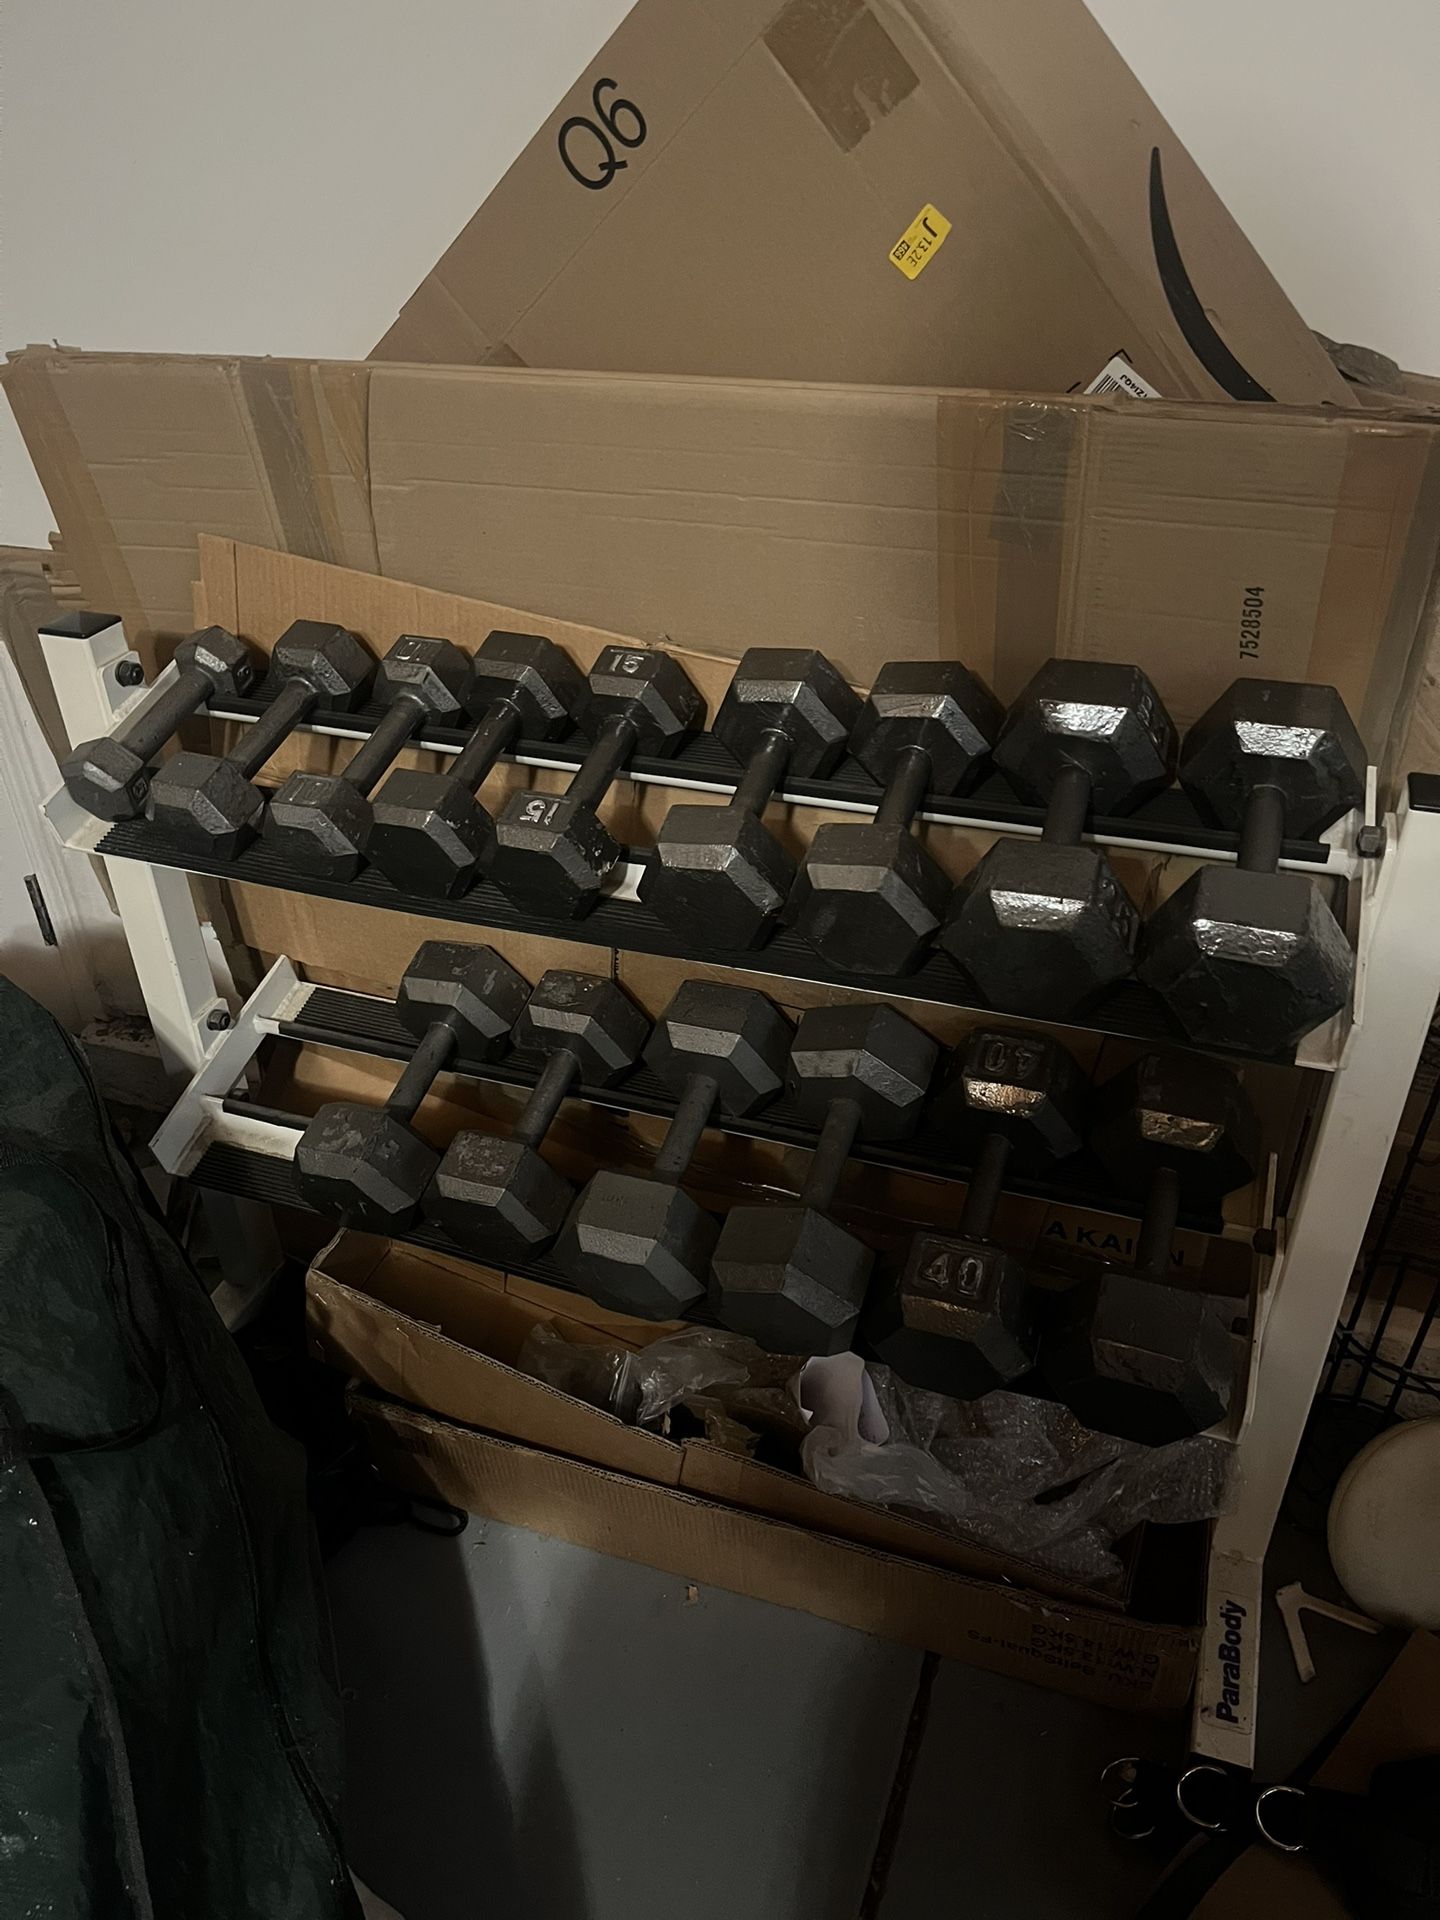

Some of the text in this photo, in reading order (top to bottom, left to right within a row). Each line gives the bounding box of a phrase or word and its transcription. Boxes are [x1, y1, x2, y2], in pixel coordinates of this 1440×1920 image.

[558, 78, 648, 191] Q6
[1240, 586, 1265, 660] 7528504
[609, 651, 646, 674] 15
[518, 797, 558, 827] 15
[984, 1042, 1040, 1074] 40
[922, 1253, 985, 1297] 40
[1216, 1599, 1248, 1725] ParaBody
